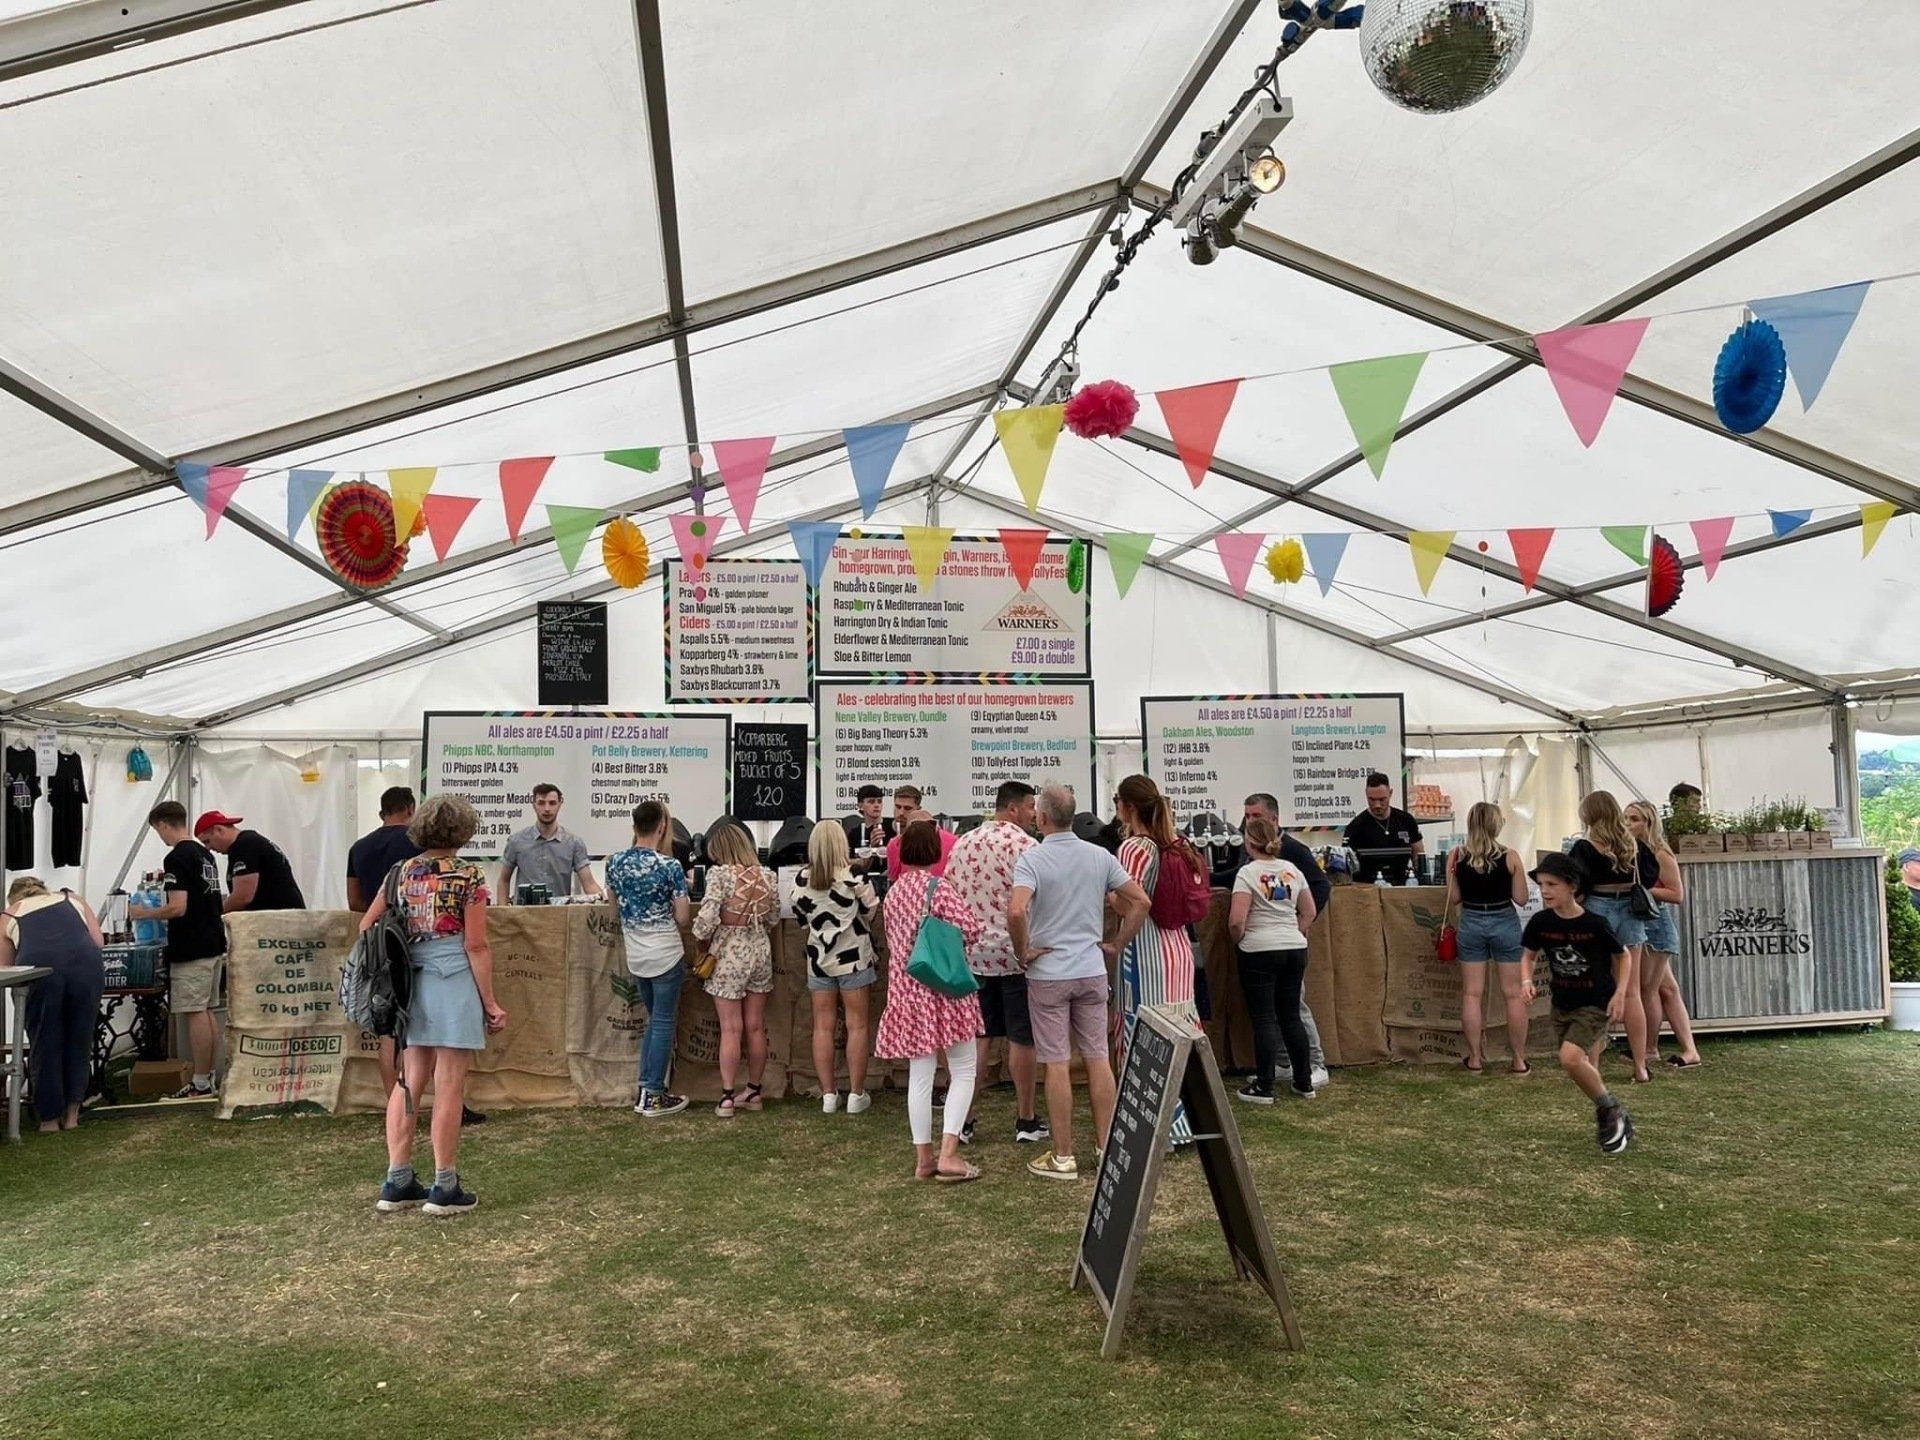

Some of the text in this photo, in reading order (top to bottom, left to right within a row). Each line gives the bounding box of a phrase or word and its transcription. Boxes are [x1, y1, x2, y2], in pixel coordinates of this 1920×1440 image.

[832, 546, 1000, 563] Gin Warners,
[839, 561, 896, 576] homegrown,
[949, 565, 978, 576] stones
[980, 565, 1005, 576] throw
[716, 574, 780, 583] £5.00 £2.50
[834, 581, 917, 594] Rhubarb Ginger Ale
[724, 590, 768, 599] golden pilsner
[679, 602, 736, 615] San Miguel 5%
[885, 600, 964, 612] Mediterranean Tonic
[680, 616, 779, 629] Ciders £5.00 £2.50
[834, 616, 948, 628] Harrington Dry Indian Tonic
[998, 617, 1058, 630] WARNER'S
[680, 634, 794, 645] Aspalls 5.5% sweetness
[834, 633, 968, 646] Elderflower Mediterranean Tonic
[1016, 637, 1075, 651] £7.00 single
[680, 649, 777, 661] Kopparberg strawberry
[834, 651, 911, 662] Sloe Bitter Lemon
[1012, 651, 1075, 664] £9.00 double
[680, 664, 764, 676] Saxbys Rhubarb 3.8%
[680, 680, 780, 691] Saxbys Blackcurrant 3.7%
[837, 693, 1074, 706] Ales celebrating the best of our homegrown brewers
[835, 712, 856, 722] Nene
[858, 712, 882, 723] Valley
[920, 711, 947, 722] Oundle
[1015, 711, 1038, 721] Queen
[1198, 706, 1352, 720] All ales are £4.50 pint £2.25 half
[488, 725, 669, 740] All ales are £4.50 pint £2.25 half
[848, 728, 908, 740] Big Bang Theory
[1162, 726, 1254, 738] Oakham Woodston
[1291, 725, 1325, 736] Langtons
[1358, 724, 1386, 735] Langton
[443, 744, 554, 757] Phipps Northampton
[971, 740, 1010, 752] Brewpoint
[1047, 740, 1076, 750] Bedford
[1178, 743, 1191, 753] JHB
[1306, 740, 1353, 750] Inclined Plane
[592, 745, 606, 756] Pot
[608, 745, 629, 757] Belly
[670, 746, 708, 758] Kettering
[847, 758, 901, 768] Blond session
[987, 756, 1042, 768] TollyFest Tipple
[454, 762, 519, 775] Phipps IPA 4.3%
[605, 763, 623, 774] Best
[625, 763, 647, 774] Bitter
[789, 762, 801, 779] 5
[1307, 768, 1360, 779] Rainbow Bridge
[856, 773, 888, 781] refreshing
[1179, 771, 1205, 781] Inferno
[442, 778, 503, 788] bittersweet golden
[591, 779, 620, 787] chestnut
[605, 793, 627, 805] Crazy
[1180, 800, 1198, 810] Citra
[1307, 797, 1334, 807] Toplock
[484, 809, 522, 818] amber-gold
[608, 809, 630, 818] golden
[258, 939, 326, 950] EXCELSO
[1698, 934, 1810, 958] WARNER'S
[274, 950, 314, 964] CAFÉ
[285, 968, 305, 978] DE
[105, 976, 127, 986] IDER
[255, 982, 334, 994] COLOMBIA
[260, 1002, 331, 1016] 70 kg NET
